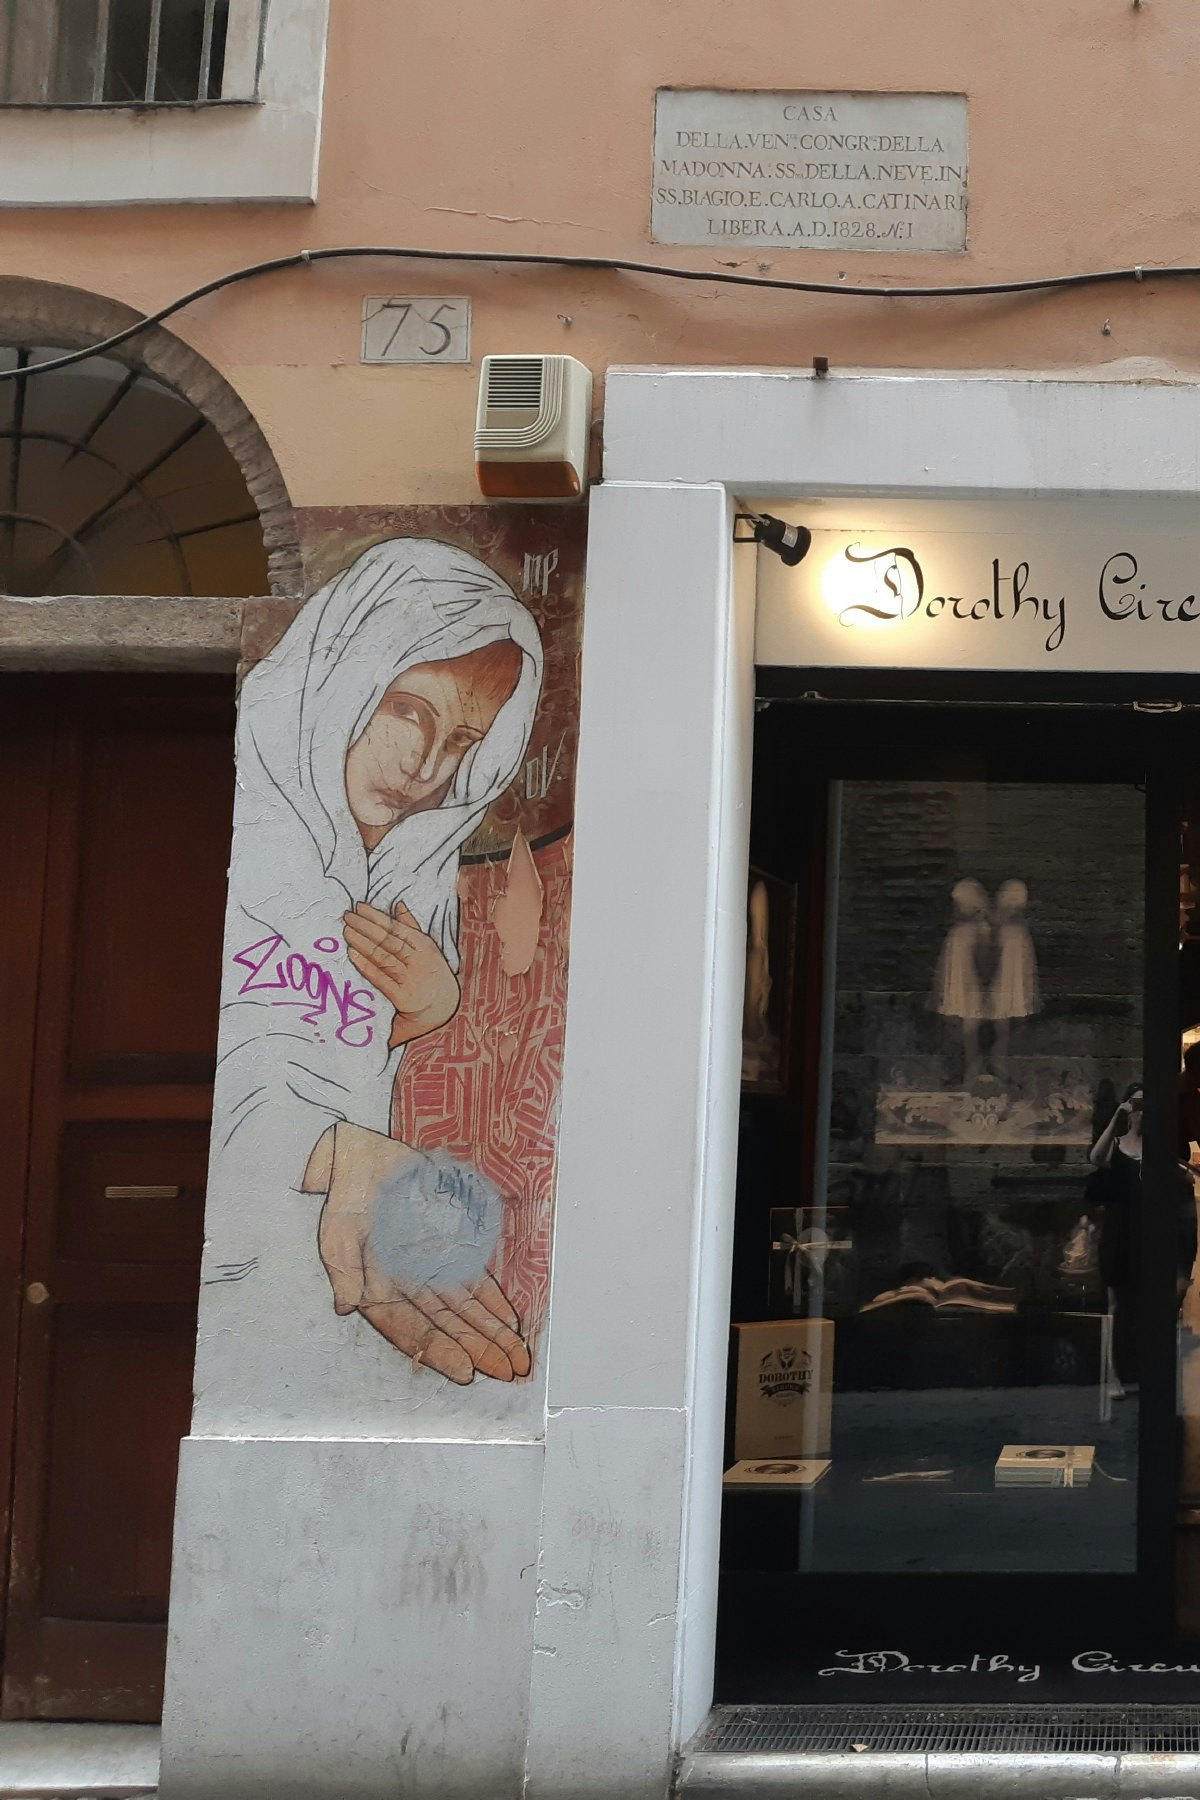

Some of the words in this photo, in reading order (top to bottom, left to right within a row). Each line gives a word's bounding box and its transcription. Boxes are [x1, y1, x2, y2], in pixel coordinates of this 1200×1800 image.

[783, 105, 839, 121] CASA
[381, 303, 456, 356] 75
[839, 541, 1066, 652] Dorothy
[758, 1369, 814, 1384] DOROTHY
[818, 1650, 1041, 1682] Dorothy
